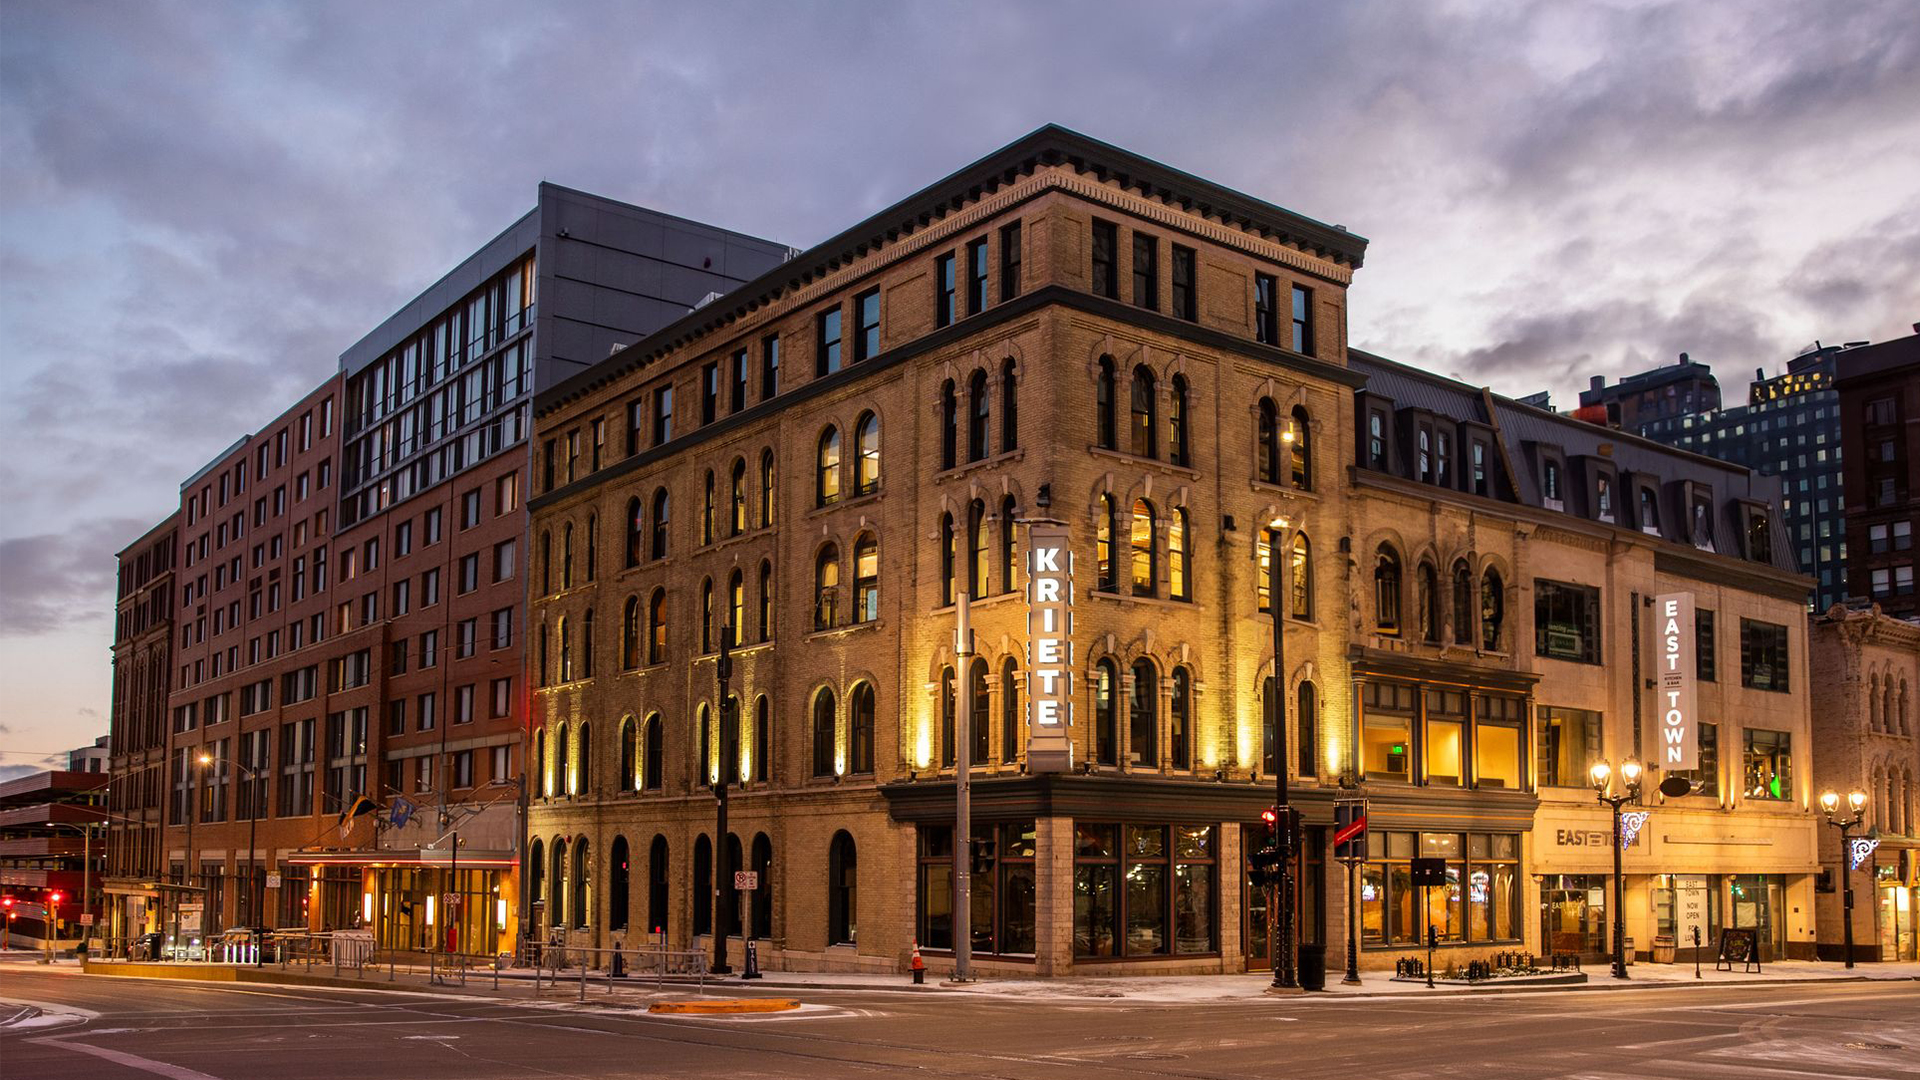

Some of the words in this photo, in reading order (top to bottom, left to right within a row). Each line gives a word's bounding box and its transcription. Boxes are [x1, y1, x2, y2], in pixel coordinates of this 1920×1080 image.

[1036, 548, 1060, 725] KRIETE
[1664, 600, 1680, 671] EAST
[1664, 691, 1685, 763] TOWN
[1556, 829, 1588, 847] EAST
[1686, 902, 1699, 910] NOW
[1686, 911, 1700, 920] OPEN
